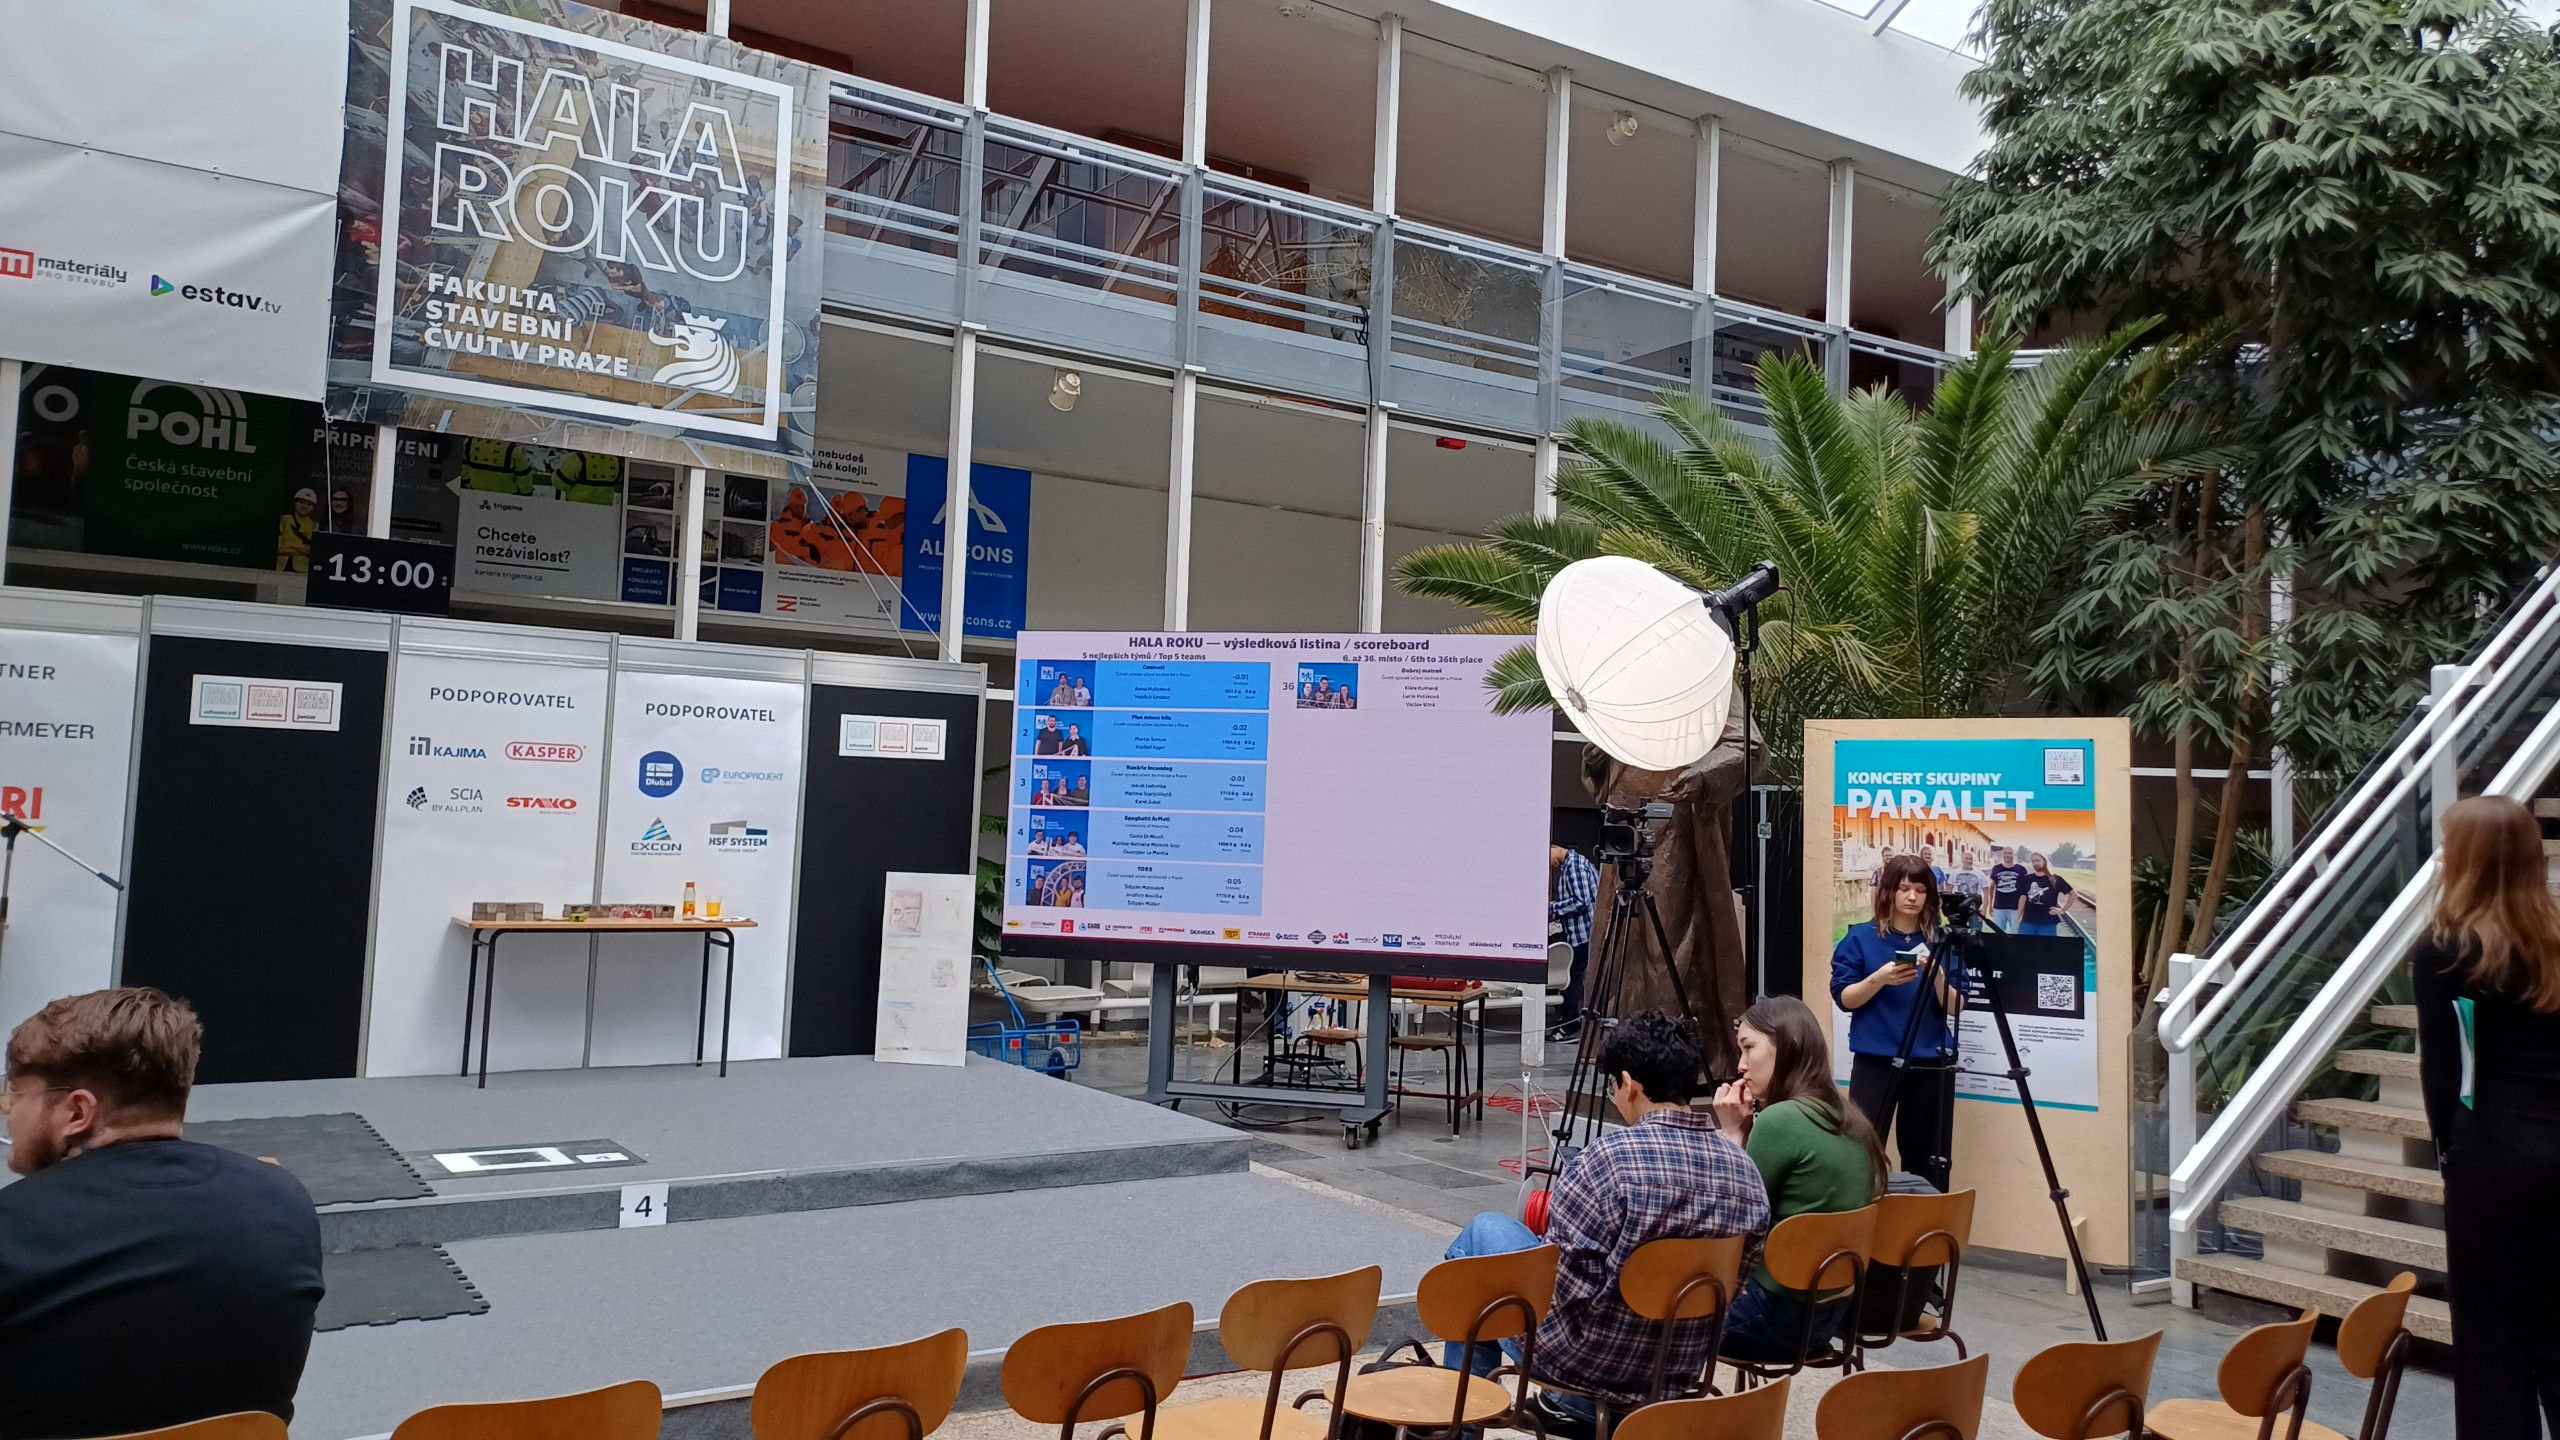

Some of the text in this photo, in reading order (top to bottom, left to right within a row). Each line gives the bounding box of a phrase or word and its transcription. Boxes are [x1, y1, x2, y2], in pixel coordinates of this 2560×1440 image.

[437, 42, 748, 192] HALA
[430, 142, 749, 282] ROKU
[37, 270, 115, 288] PRO STAVBU
[181, 284, 281, 314] estav.tv
[428, 273, 557, 313] FAKULTA
[425, 300, 574, 341] STAVEBNÍ
[424, 324, 629, 377] ČVUT V PRAZE
[127, 407, 256, 453] POHL
[818, 450, 865, 463] nebudeš
[125, 453, 253, 483] Česká stavební
[812, 460, 833, 470] uhé
[124, 478, 218, 499] společnost
[493, 502, 523, 512] trigema
[477, 526, 537, 545] Chcete
[475, 545, 571, 564] nezávislost?
[919, 538, 1014, 564] ALONS
[329, 553, 435, 589] 13:00
[1129, 637, 1164, 648] HALA
[1166, 637, 1204, 648] ROKU
[1223, 637, 1297, 650] výsledková
[1299, 638, 1341, 650] listina
[1353, 639, 1430, 651] scoreboard
[1089, 652, 1129, 661] nejlepších
[1130, 652, 1152, 661] týmů
[1159, 652, 1173, 661] Top
[1378, 655, 1403, 663] místo
[1410, 655, 1425, 663] 6th
[1438, 655, 1458, 663] 36th
[1459, 656, 1483, 664] place
[1025, 678, 1031, 688] 1
[1282, 681, 1295, 691] 36
[430, 687, 575, 709] PODPOROVATEL
[645, 702, 776, 723] PODPOROVATEL
[1022, 728, 1029, 737] 2
[433, 746, 487, 759] KAJIMA
[512, 745, 576, 759] KASPER
[645, 778, 673, 787] Dlubal
[723, 771, 784, 782] EUROPROJEKT
[1020, 778, 1026, 787] 3
[1847, 772, 2002, 786] KONCERT SKUPINY
[450, 787, 483, 801] SCIA
[1847, 788, 2034, 822] PARALET
[1017, 828, 1024, 837] 4
[631, 842, 682, 851] EXCON
[708, 837, 768, 847] HSF SYSTEM
[1015, 878, 1022, 887] 5
[634, 1195, 653, 1218] 4
